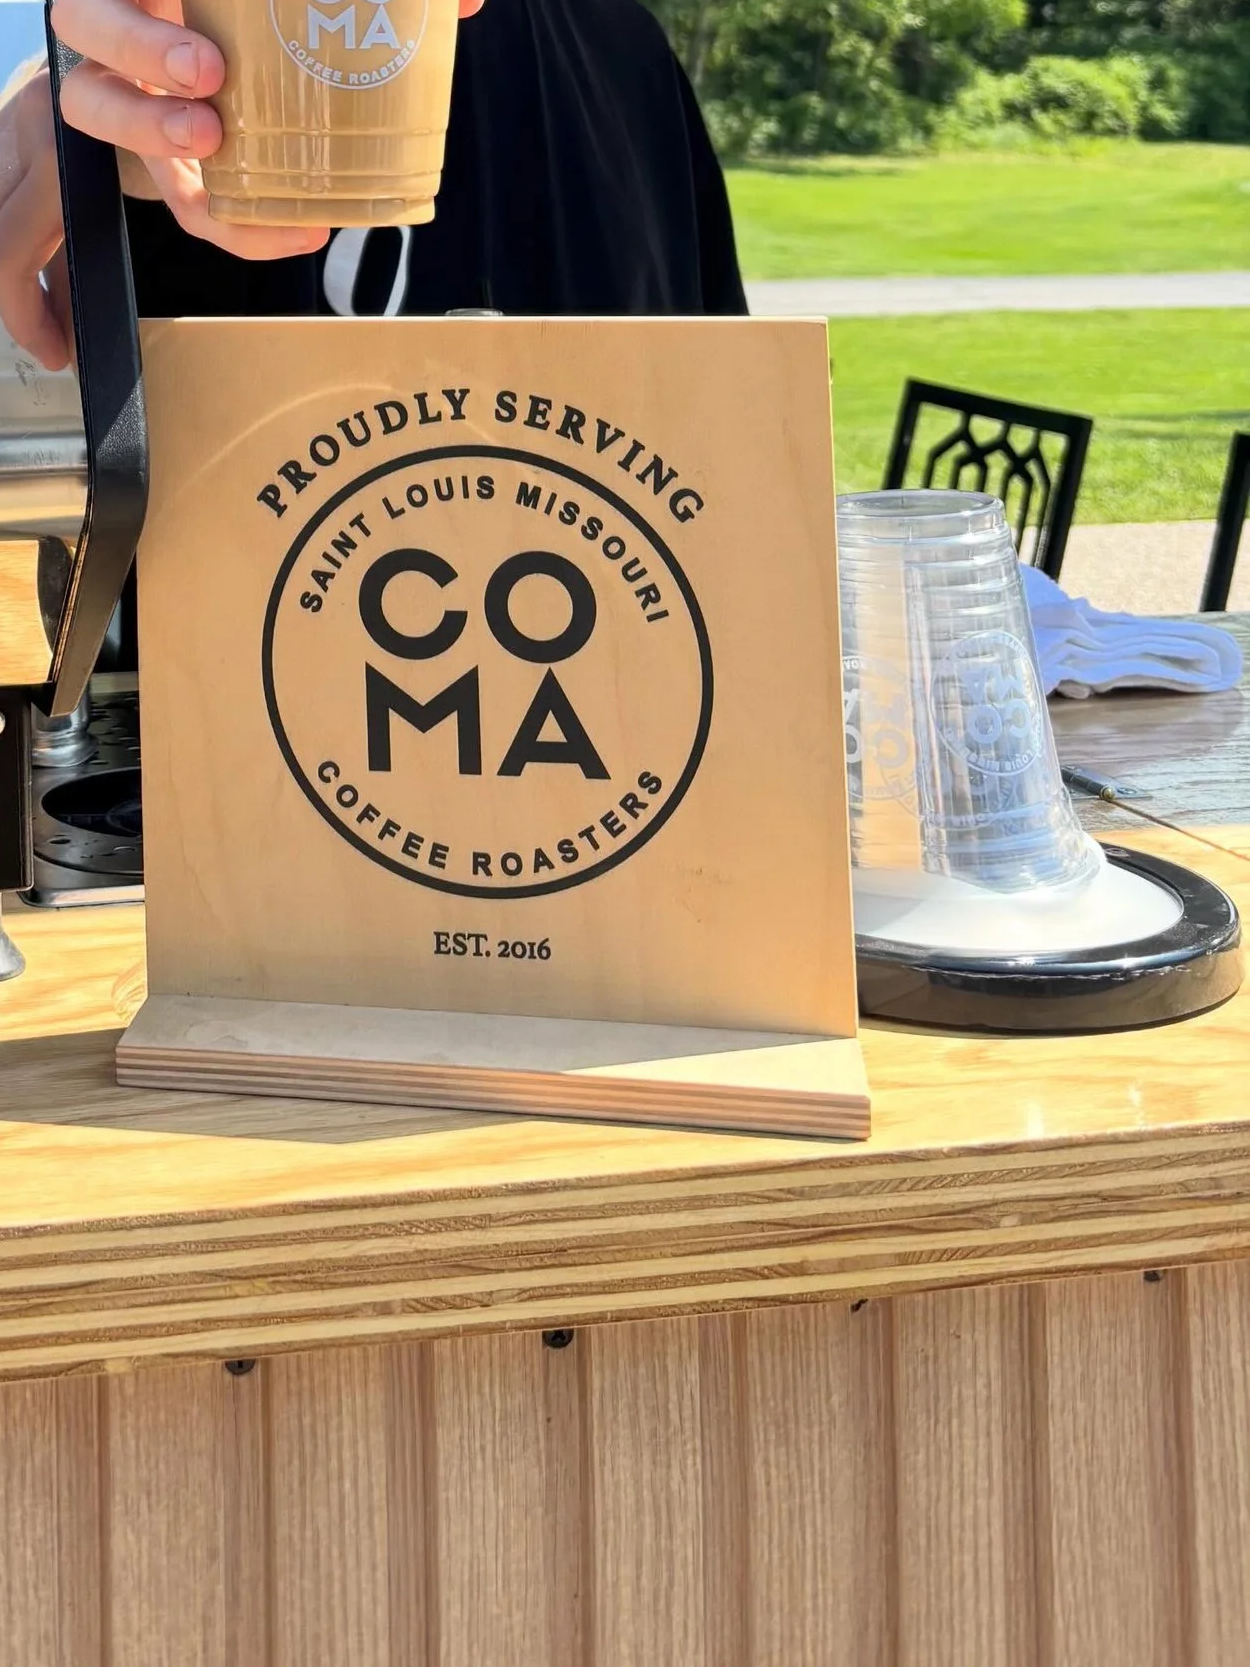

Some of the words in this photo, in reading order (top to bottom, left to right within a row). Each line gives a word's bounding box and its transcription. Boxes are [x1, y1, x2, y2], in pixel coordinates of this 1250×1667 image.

[288, 39, 343, 82] COFFEE
[348, 38, 415, 85] ROASTERS
[255, 387, 472, 520] PROUDLY
[493, 389, 706, 525] SERVING
[298, 511, 373, 614] SAINT
[380, 474, 496, 521] LOUIS
[514, 480, 671, 624] MISSOURI
[316, 759, 451, 871] COFFEE
[471, 770, 664, 878] ROASTERS
[433, 931, 492, 958] EST.
[497, 937, 553, 962] 2016
